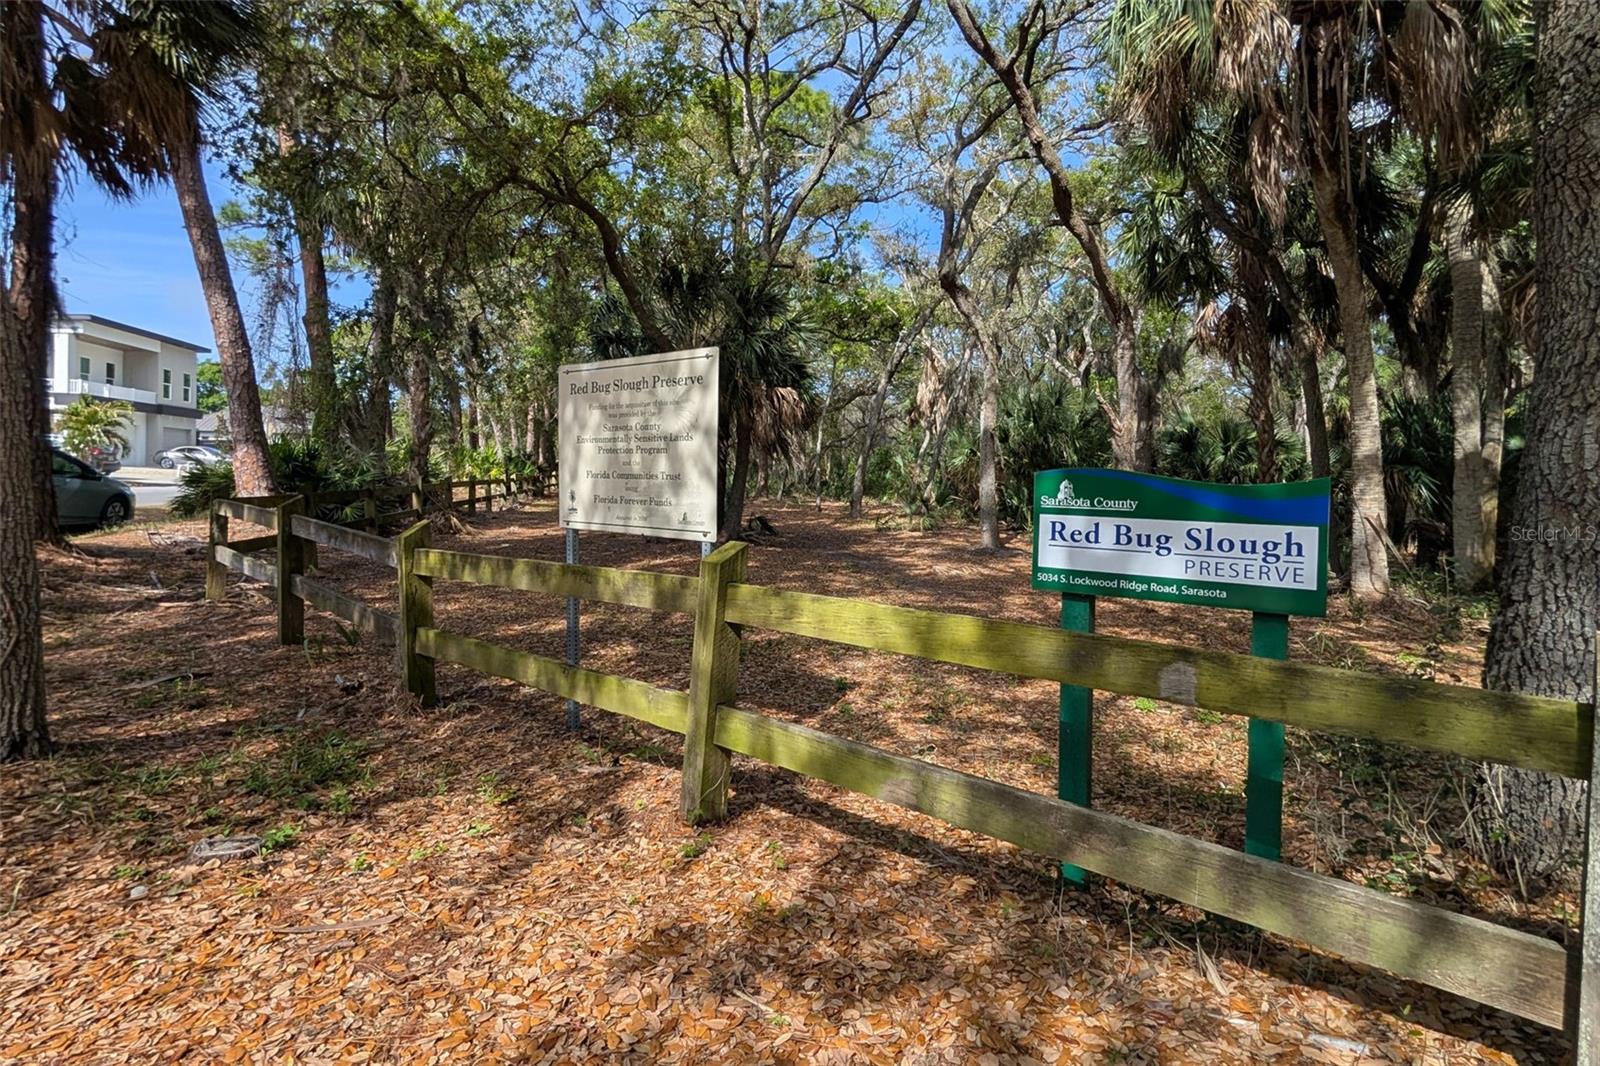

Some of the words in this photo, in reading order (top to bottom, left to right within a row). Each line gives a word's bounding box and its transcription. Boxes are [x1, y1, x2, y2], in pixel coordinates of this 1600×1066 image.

[570, 382, 588, 395] Red
[591, 381, 610, 394] Bug
[613, 378, 649, 392] Slough
[653, 375, 703, 388] Preserve
[602, 424, 632, 432] Sarasota
[634, 422, 661, 431] County
[576, 434, 632, 444] Environmentally
[634, 432, 669, 442] Sensitive
[670, 432, 694, 442] Lands
[598, 446, 633, 455] Protection
[636, 445, 668, 456] Program
[586, 470, 610, 479] Florida
[612, 470, 658, 480] Communities
[660, 472, 681, 480] Trust
[593, 495, 618, 504] Florida
[620, 496, 648, 506] Forever
[649, 497, 672, 506] Funds
[1040, 495, 1090, 506] Sarasota
[1094, 497, 1138, 509] County
[1050, 520, 1101, 544] Red
[1113, 524, 1173, 556] Bug
[1184, 528, 1305, 564] Slough
[1185, 560, 1304, 584] PRESERVE
[1037, 572, 1058, 582] 5034
[1060, 574, 1068, 583] S.
[1070, 576, 1117, 588] Lockwood
[1120, 579, 1148, 592] Ridge
[1150, 583, 1179, 595] Road,
[1181, 586, 1227, 598] Sarasota
